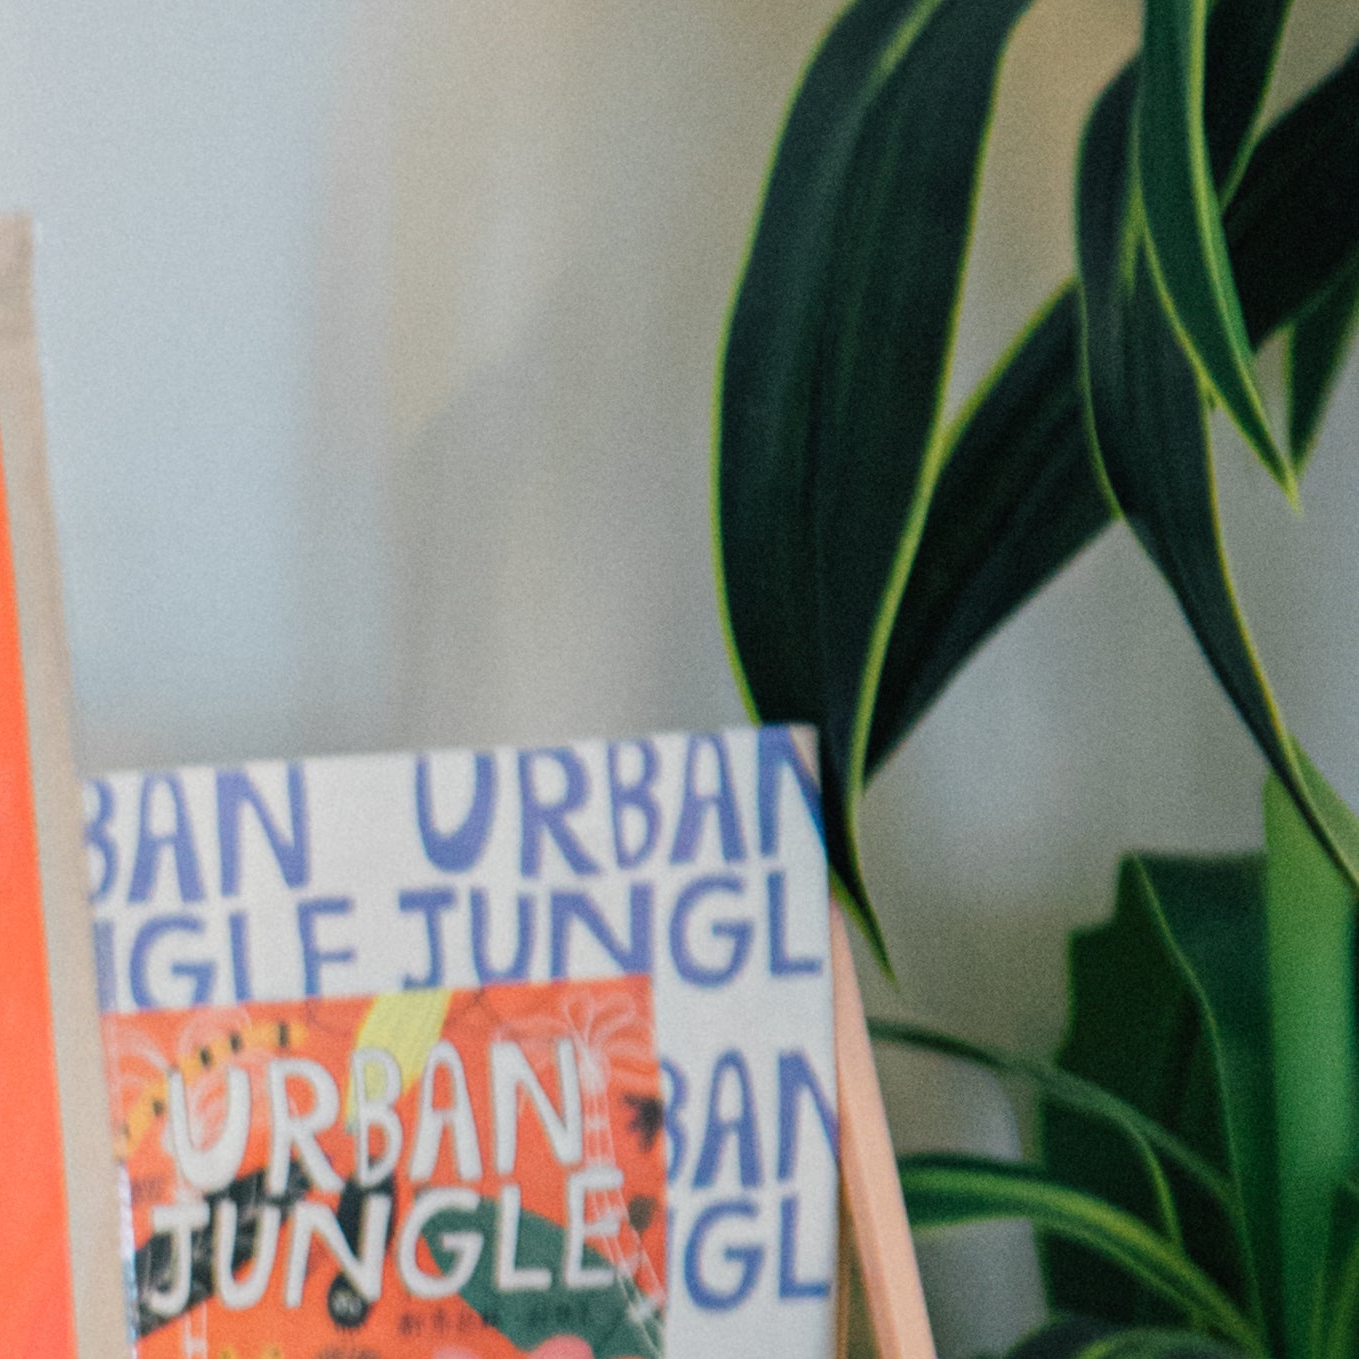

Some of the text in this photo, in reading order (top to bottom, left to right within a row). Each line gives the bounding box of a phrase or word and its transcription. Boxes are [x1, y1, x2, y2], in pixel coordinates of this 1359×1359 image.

[415, 723, 829, 879] URBAN
[167, 1038, 586, 1195] URBAN
[148, 1166, 624, 1316] JUNGLE
